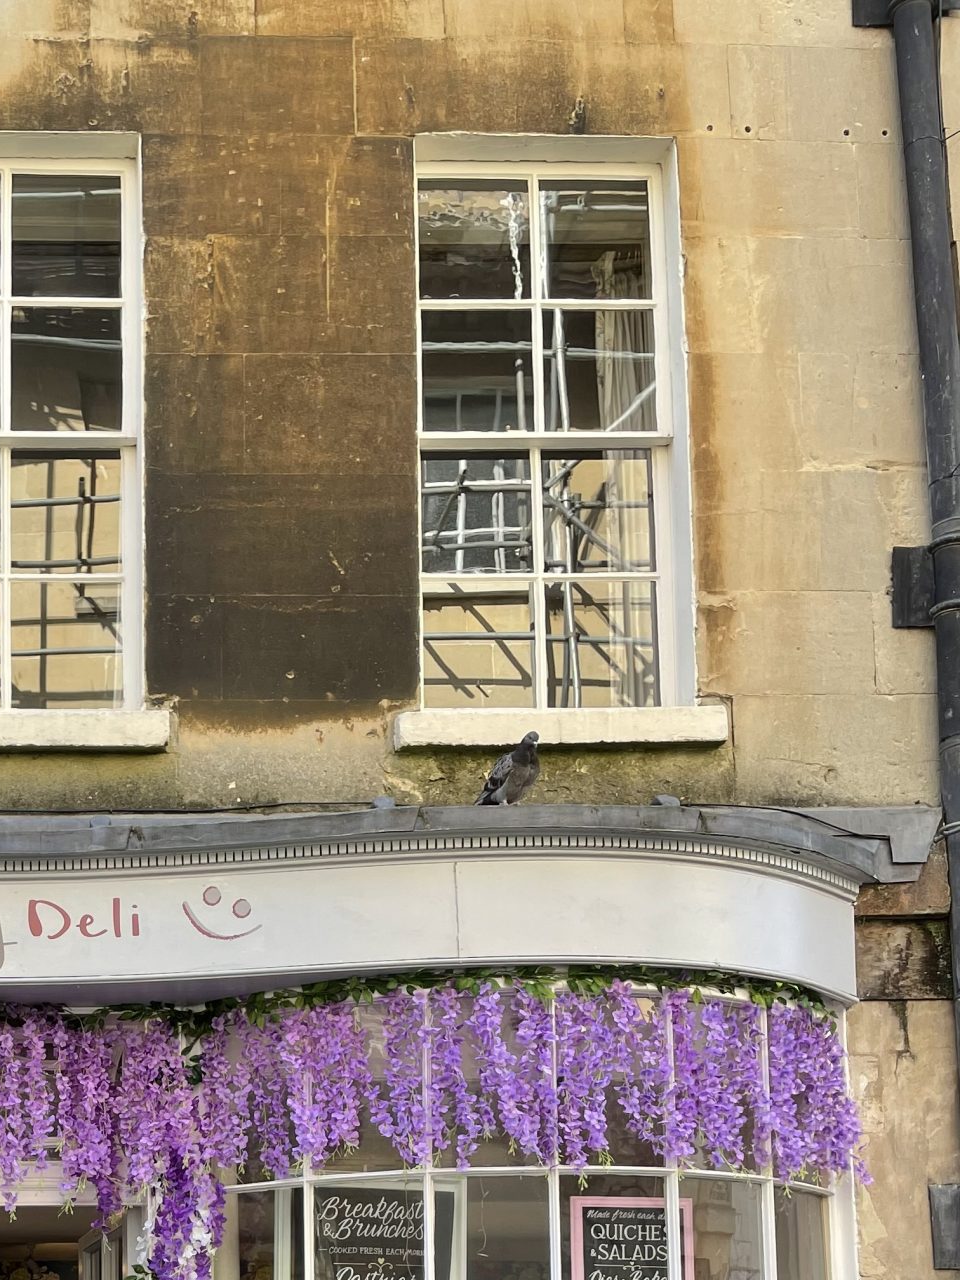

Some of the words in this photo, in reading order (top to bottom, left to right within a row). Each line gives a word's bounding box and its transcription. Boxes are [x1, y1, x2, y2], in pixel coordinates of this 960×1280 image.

[27, 897, 141, 940] Deli
[317, 1196, 424, 1225] Breakfast
[611, 1209, 635, 1221] fresh
[331, 1218, 424, 1240] Brunches
[329, 1246, 357, 1255] COOKED
[360, 1246, 382, 1255] FRESH
[385, 1247, 404, 1256] EACH
[597, 1243, 668, 1261] SALADS
